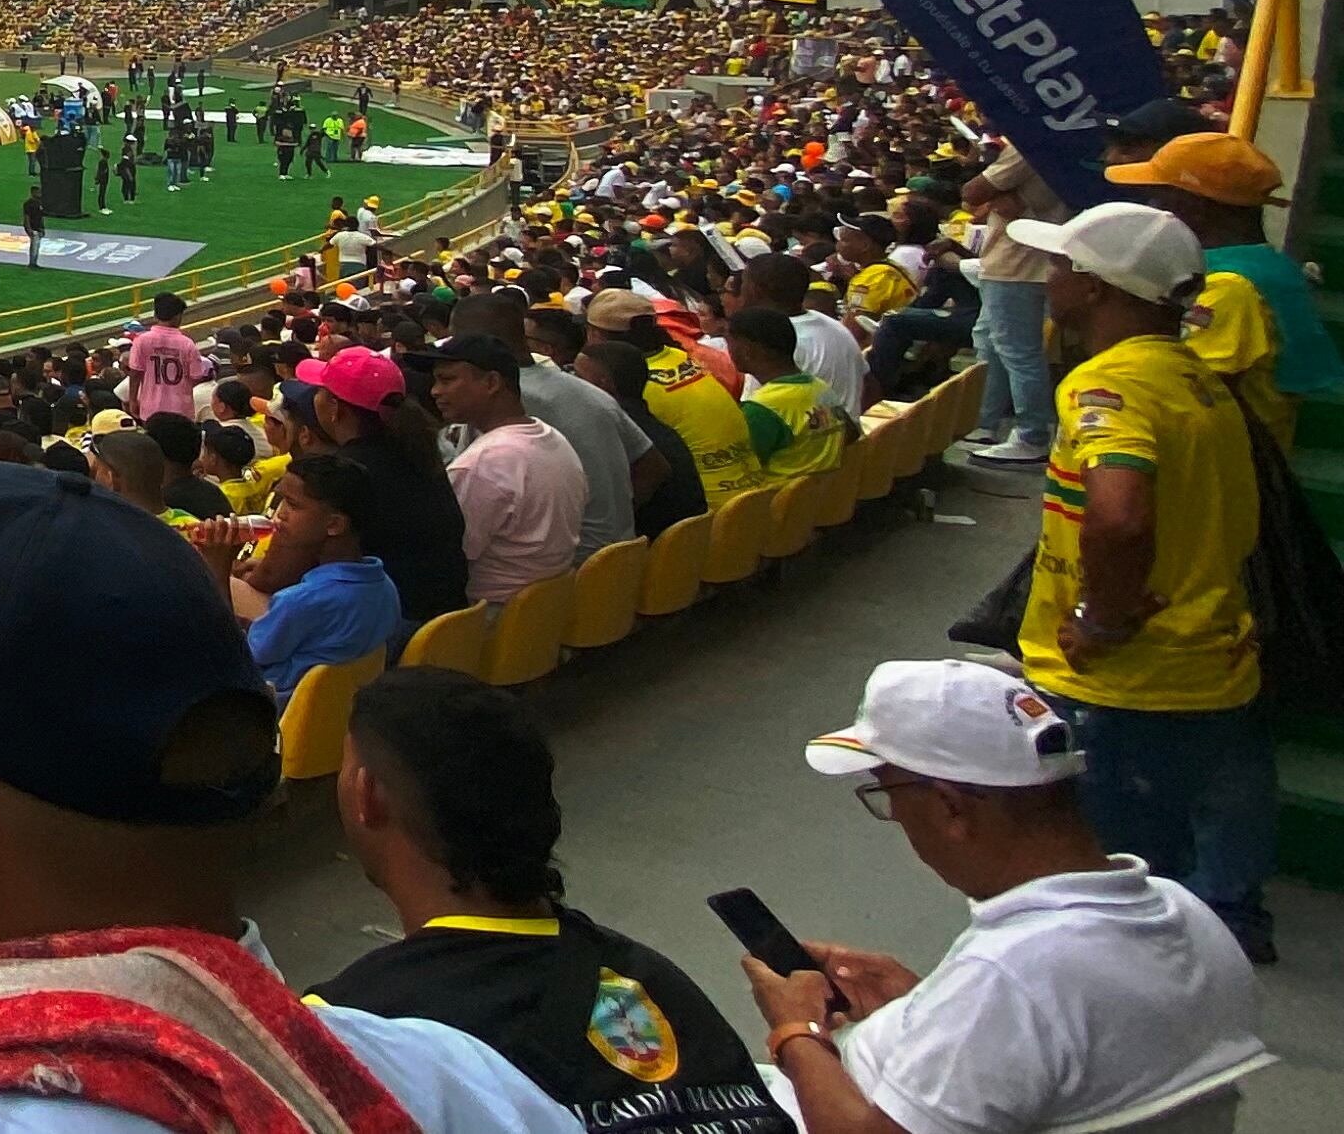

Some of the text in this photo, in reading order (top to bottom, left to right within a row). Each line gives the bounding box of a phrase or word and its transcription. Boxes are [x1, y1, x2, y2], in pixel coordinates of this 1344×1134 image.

[150, 355, 184, 386] 10
[574, 1083, 767, 1128] LCALDÍA MAYOR
